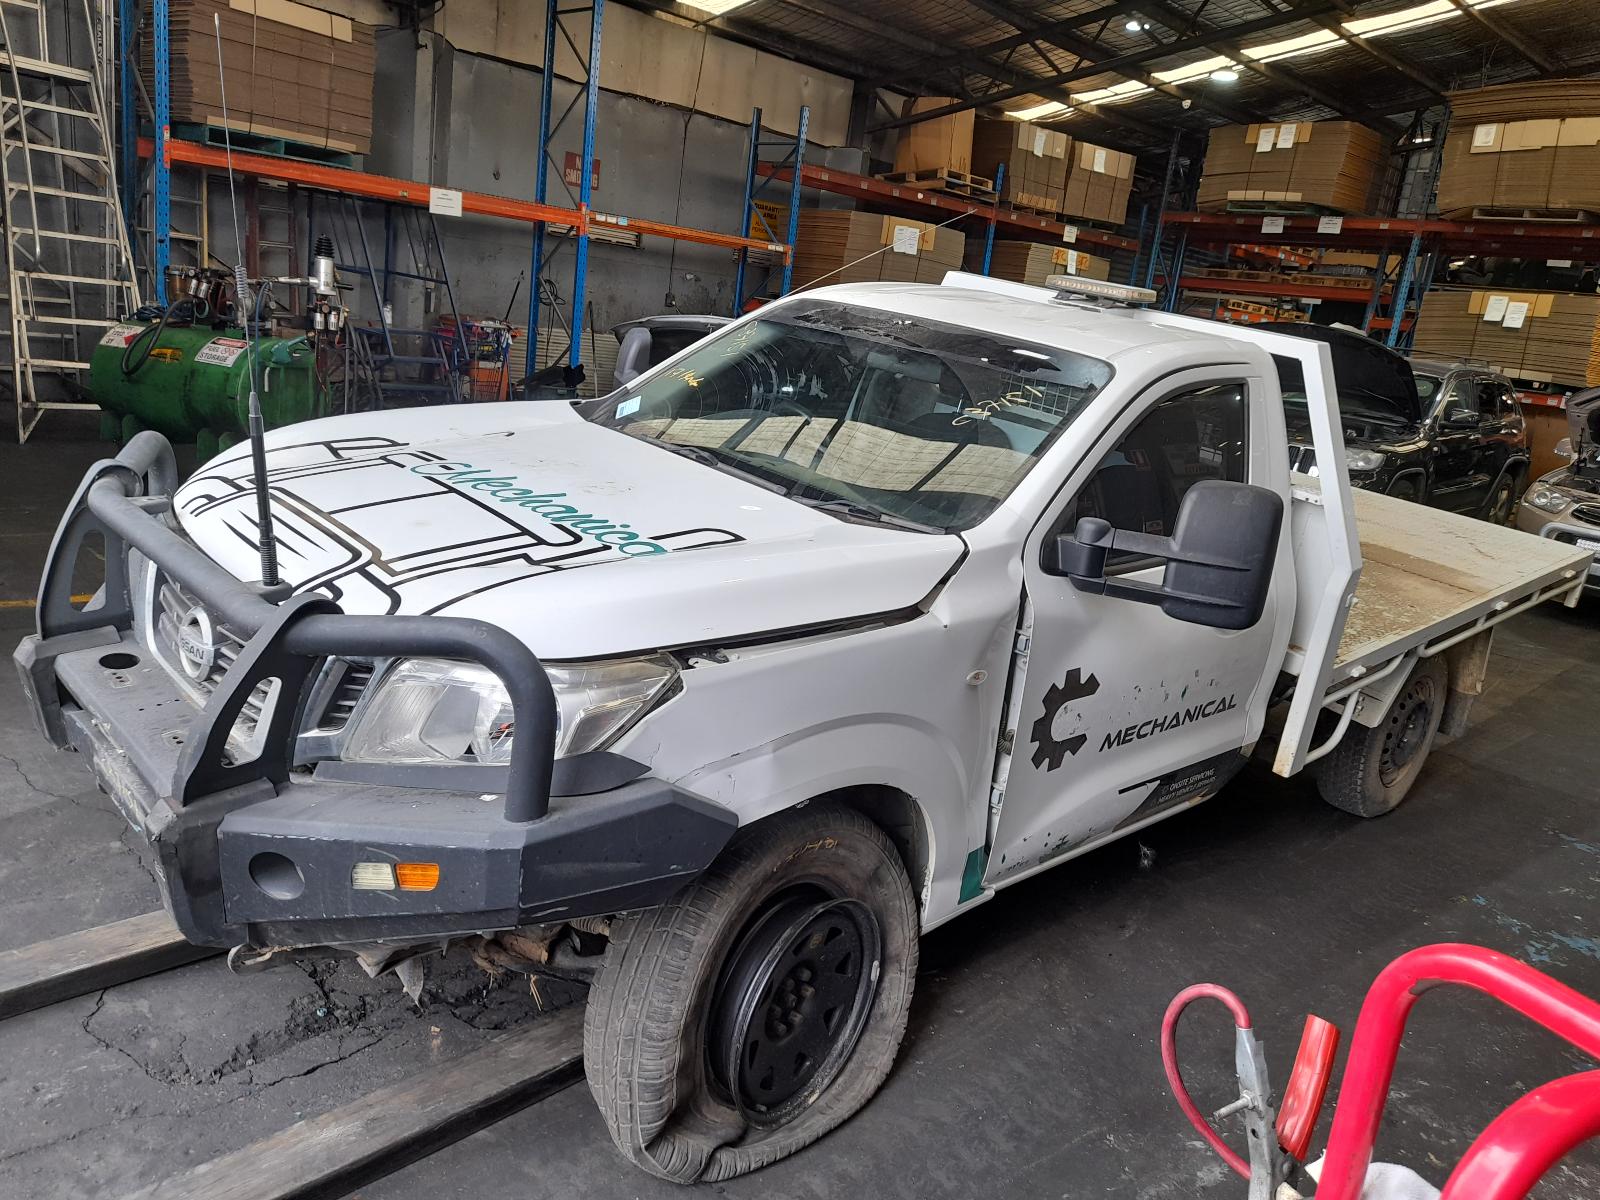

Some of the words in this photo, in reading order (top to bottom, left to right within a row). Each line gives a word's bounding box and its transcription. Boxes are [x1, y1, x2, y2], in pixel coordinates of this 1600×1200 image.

[565, 168, 598, 188] SMOG
[199, 352, 229, 362] STORAGE
[1099, 694, 1237, 753] MECHANICAL
